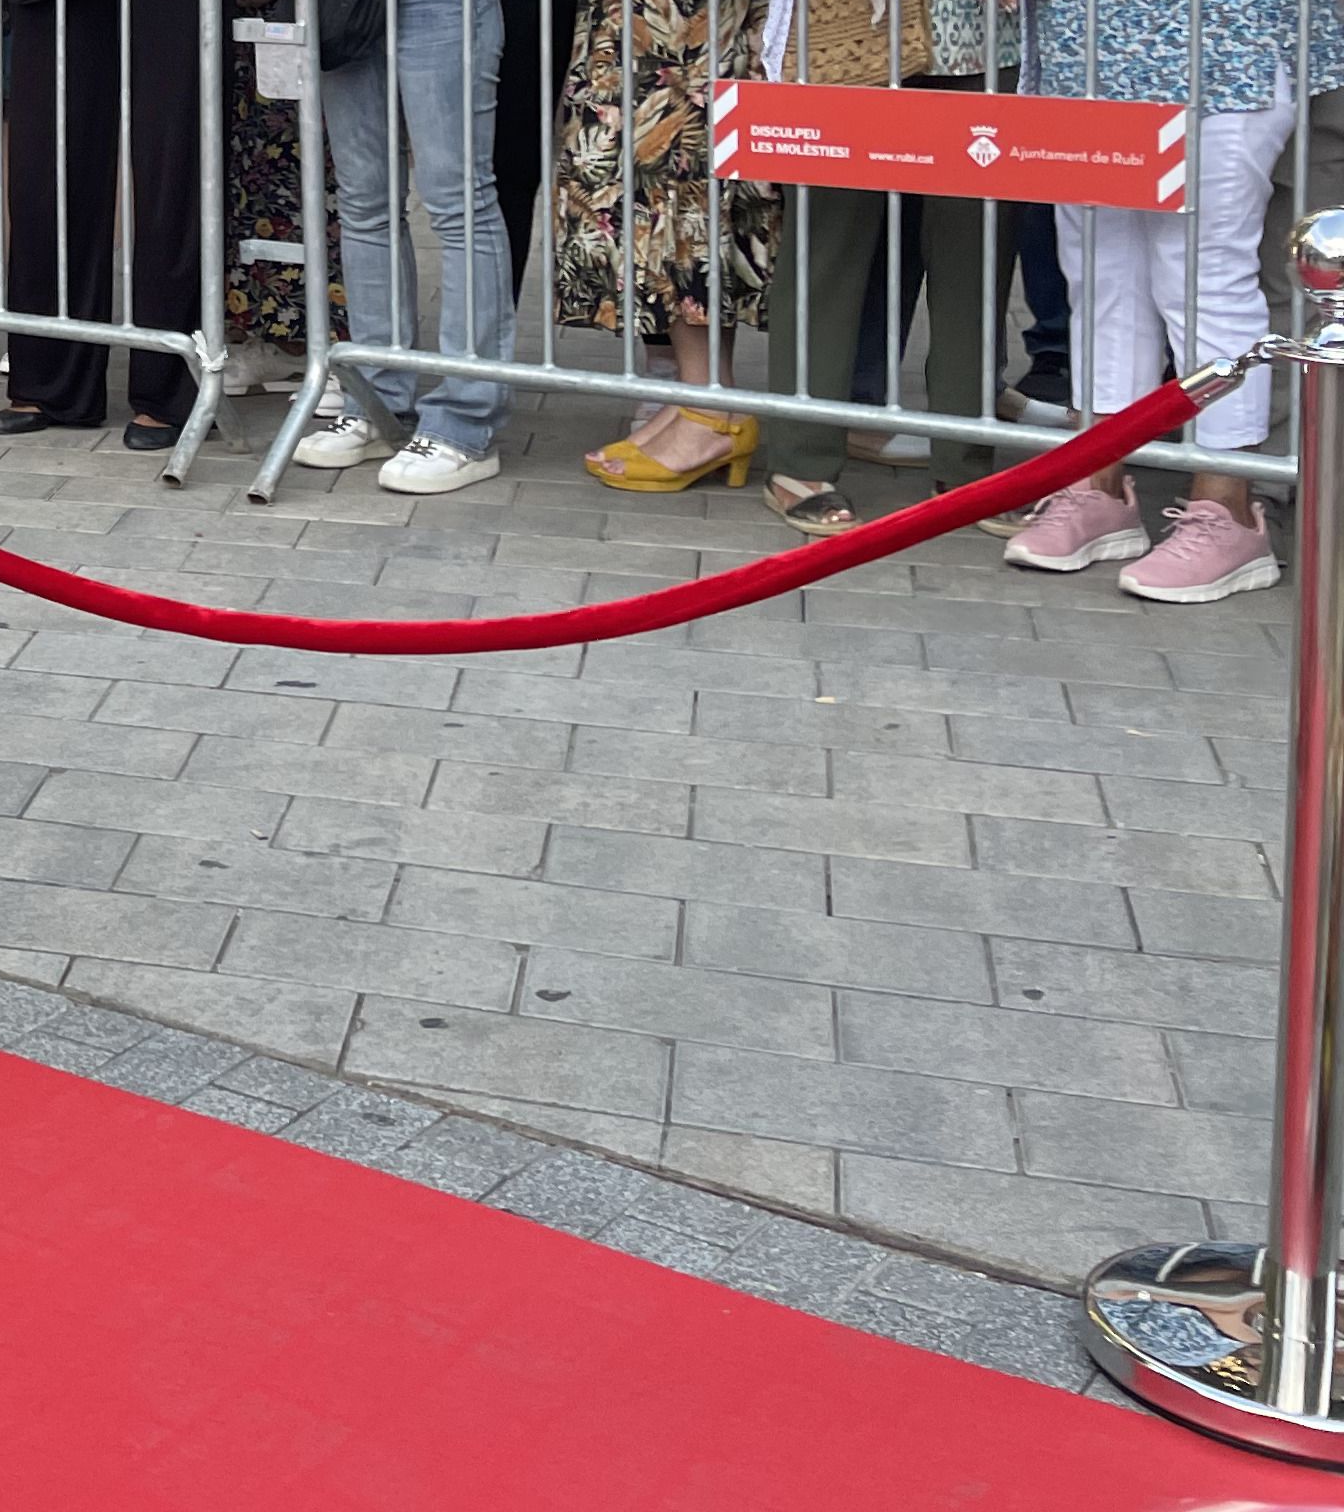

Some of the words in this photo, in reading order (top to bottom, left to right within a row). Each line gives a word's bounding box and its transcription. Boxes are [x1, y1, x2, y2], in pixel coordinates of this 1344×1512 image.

[750, 124, 821, 140] DISCULPEU
[750, 141, 774, 154] LES
[776, 142, 850, 158] MOLÈSTIES!
[1009, 146, 1089, 163] Ajuntament
[1090, 150, 1110, 164] de
[868, 152, 934, 165] www.rubi.cat
